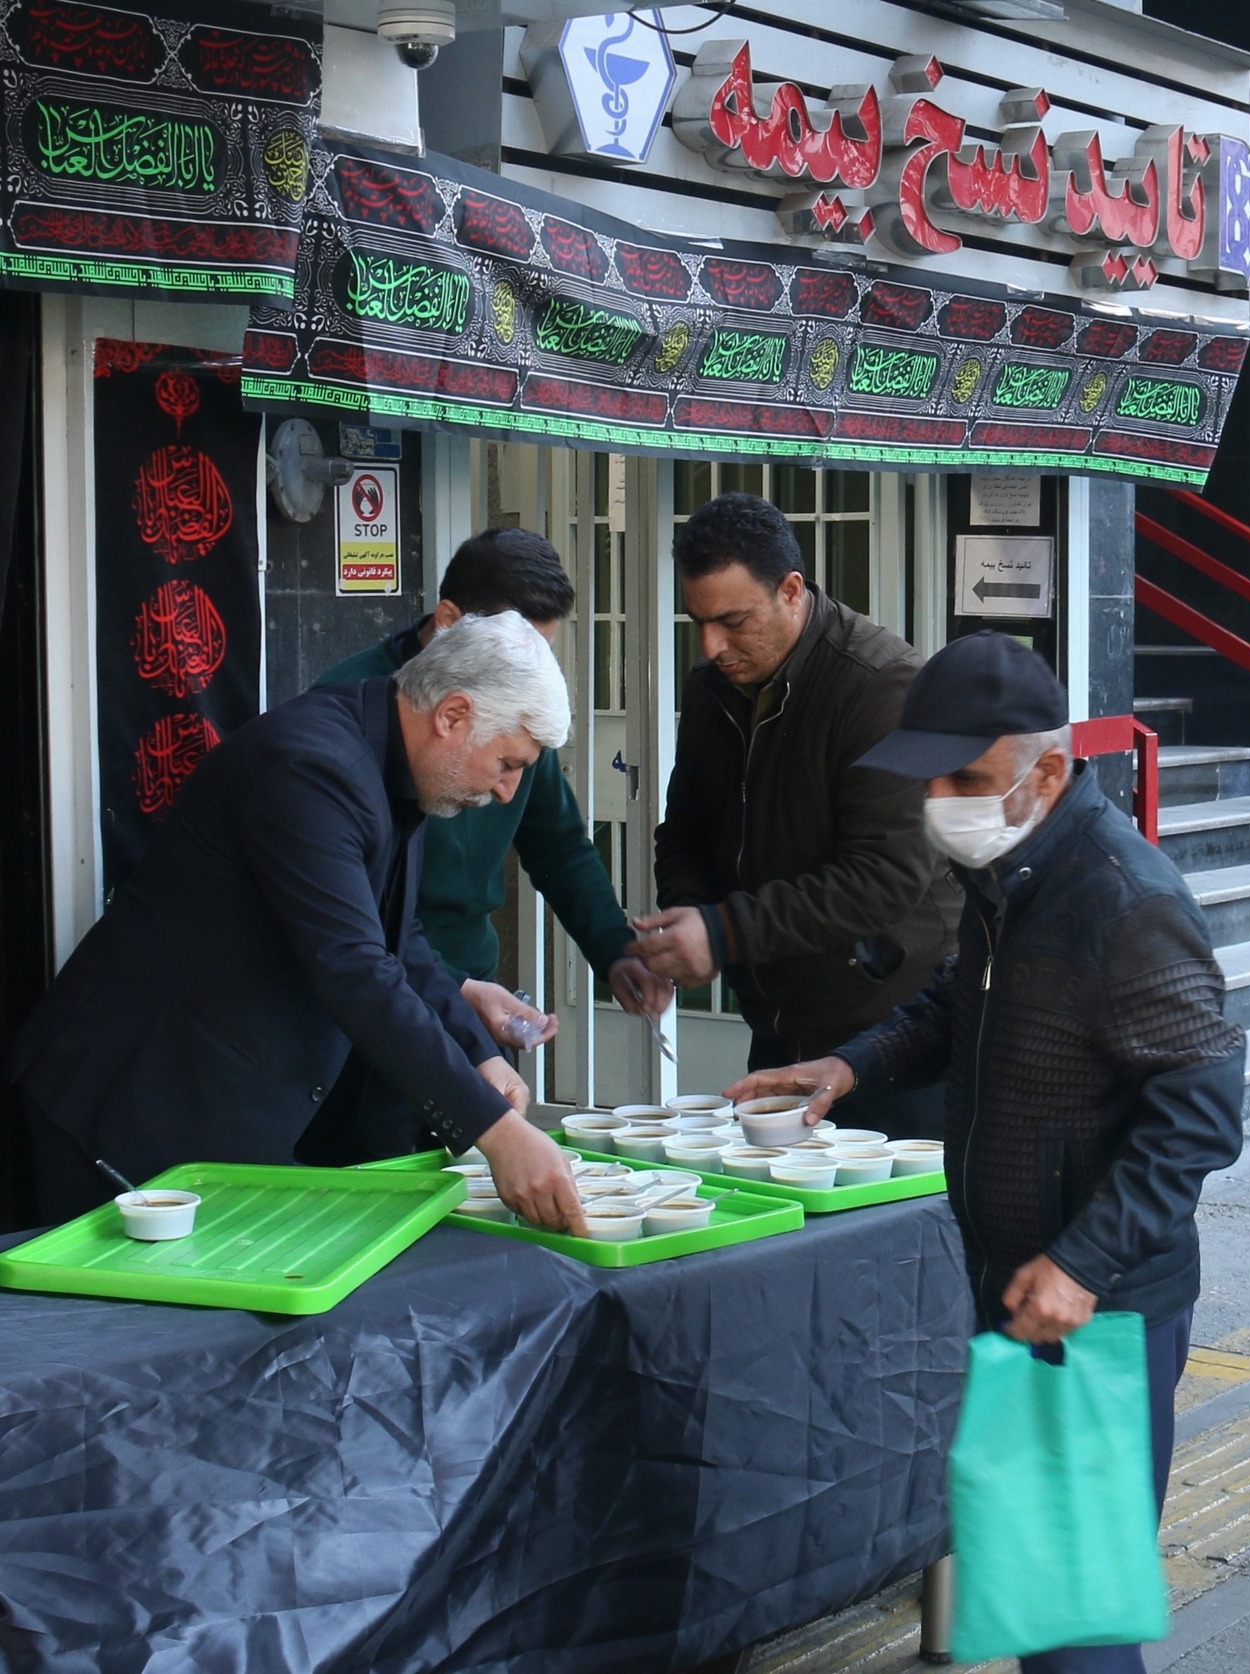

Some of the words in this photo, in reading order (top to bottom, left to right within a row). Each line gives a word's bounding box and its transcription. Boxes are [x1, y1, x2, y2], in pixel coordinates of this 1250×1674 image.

[709, 40, 882, 244] بیمه
[898, 53, 1050, 254] نسخ
[354, 523, 388, 537] STOP
[981, 560, 996, 570] بیمه
[998, 559, 1013, 572] نسخ
[343, 567, 357, 578] دارد
[357, 566, 377, 577] قانونی
[376, 567, 393, 578] پیگرد
